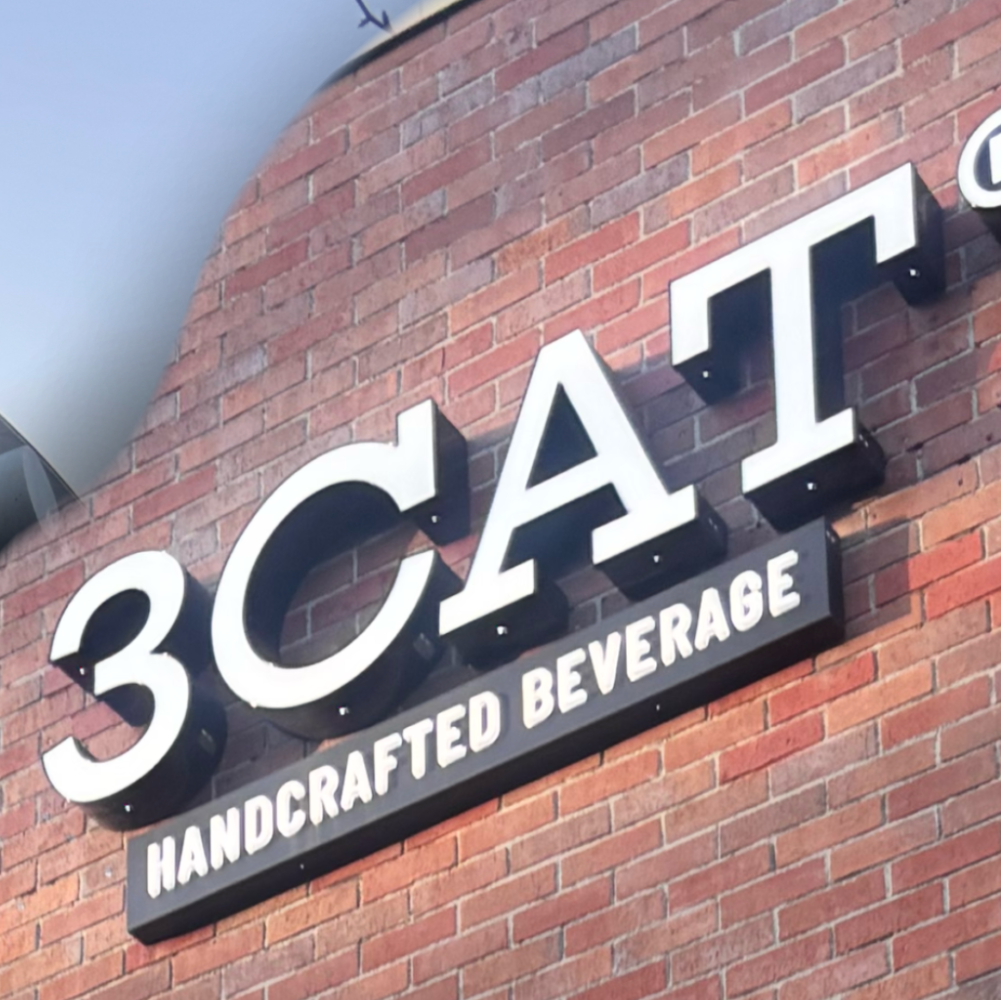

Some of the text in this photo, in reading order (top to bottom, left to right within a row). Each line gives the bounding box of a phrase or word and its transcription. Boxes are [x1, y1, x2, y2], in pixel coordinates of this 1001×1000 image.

[43, 162, 916, 804] 3CAT
[146, 690, 501, 899] HANDCRAFTED
[522, 549, 801, 729] BEVERAGE
